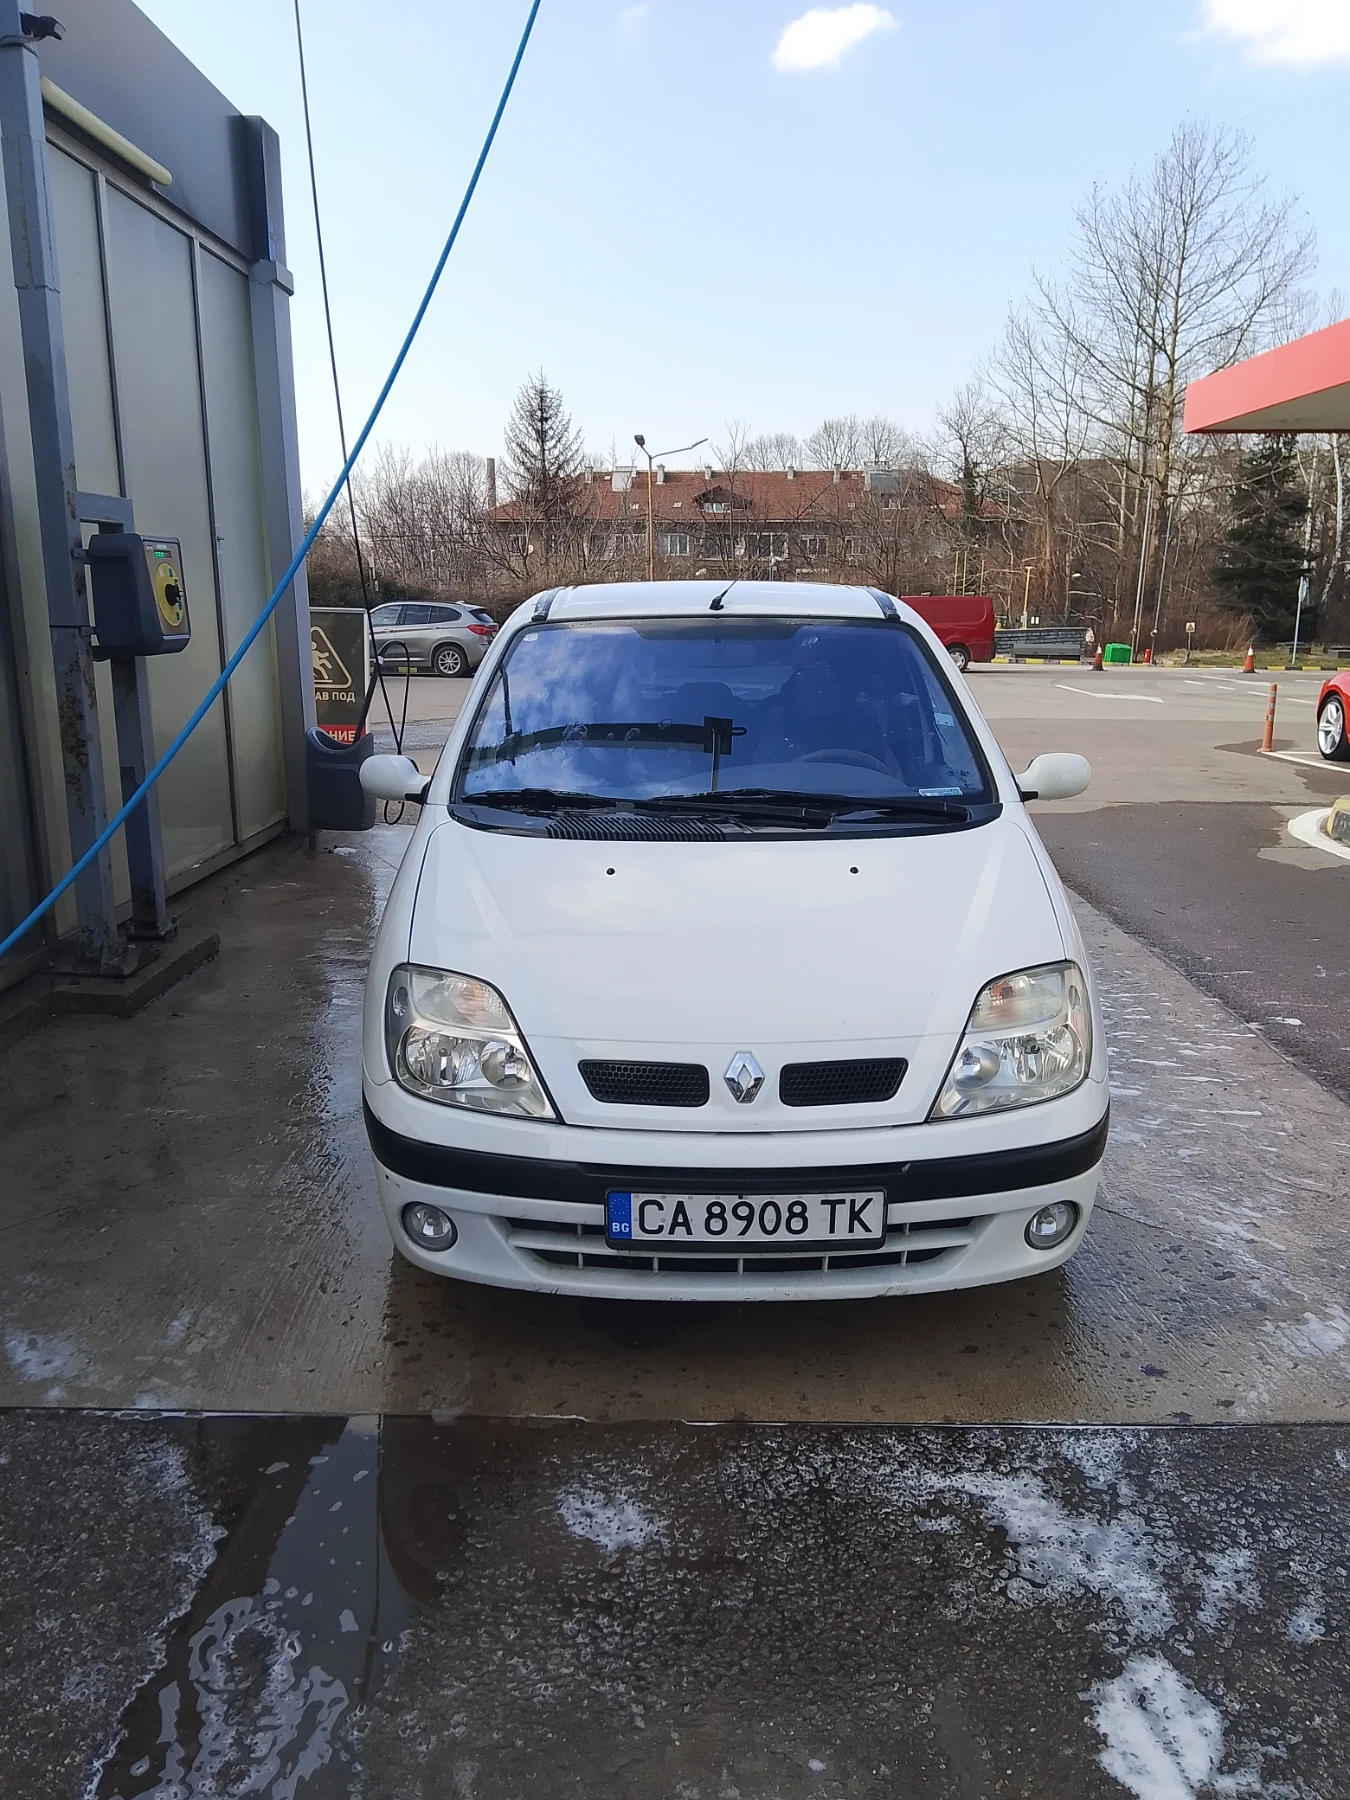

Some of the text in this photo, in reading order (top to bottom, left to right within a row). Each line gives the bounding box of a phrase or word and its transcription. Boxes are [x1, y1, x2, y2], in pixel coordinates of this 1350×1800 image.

[332, 691, 356, 703] ПОД
[638, 1198, 874, 1236] CA 8908 TK
[611, 1222, 630, 1233] BG
